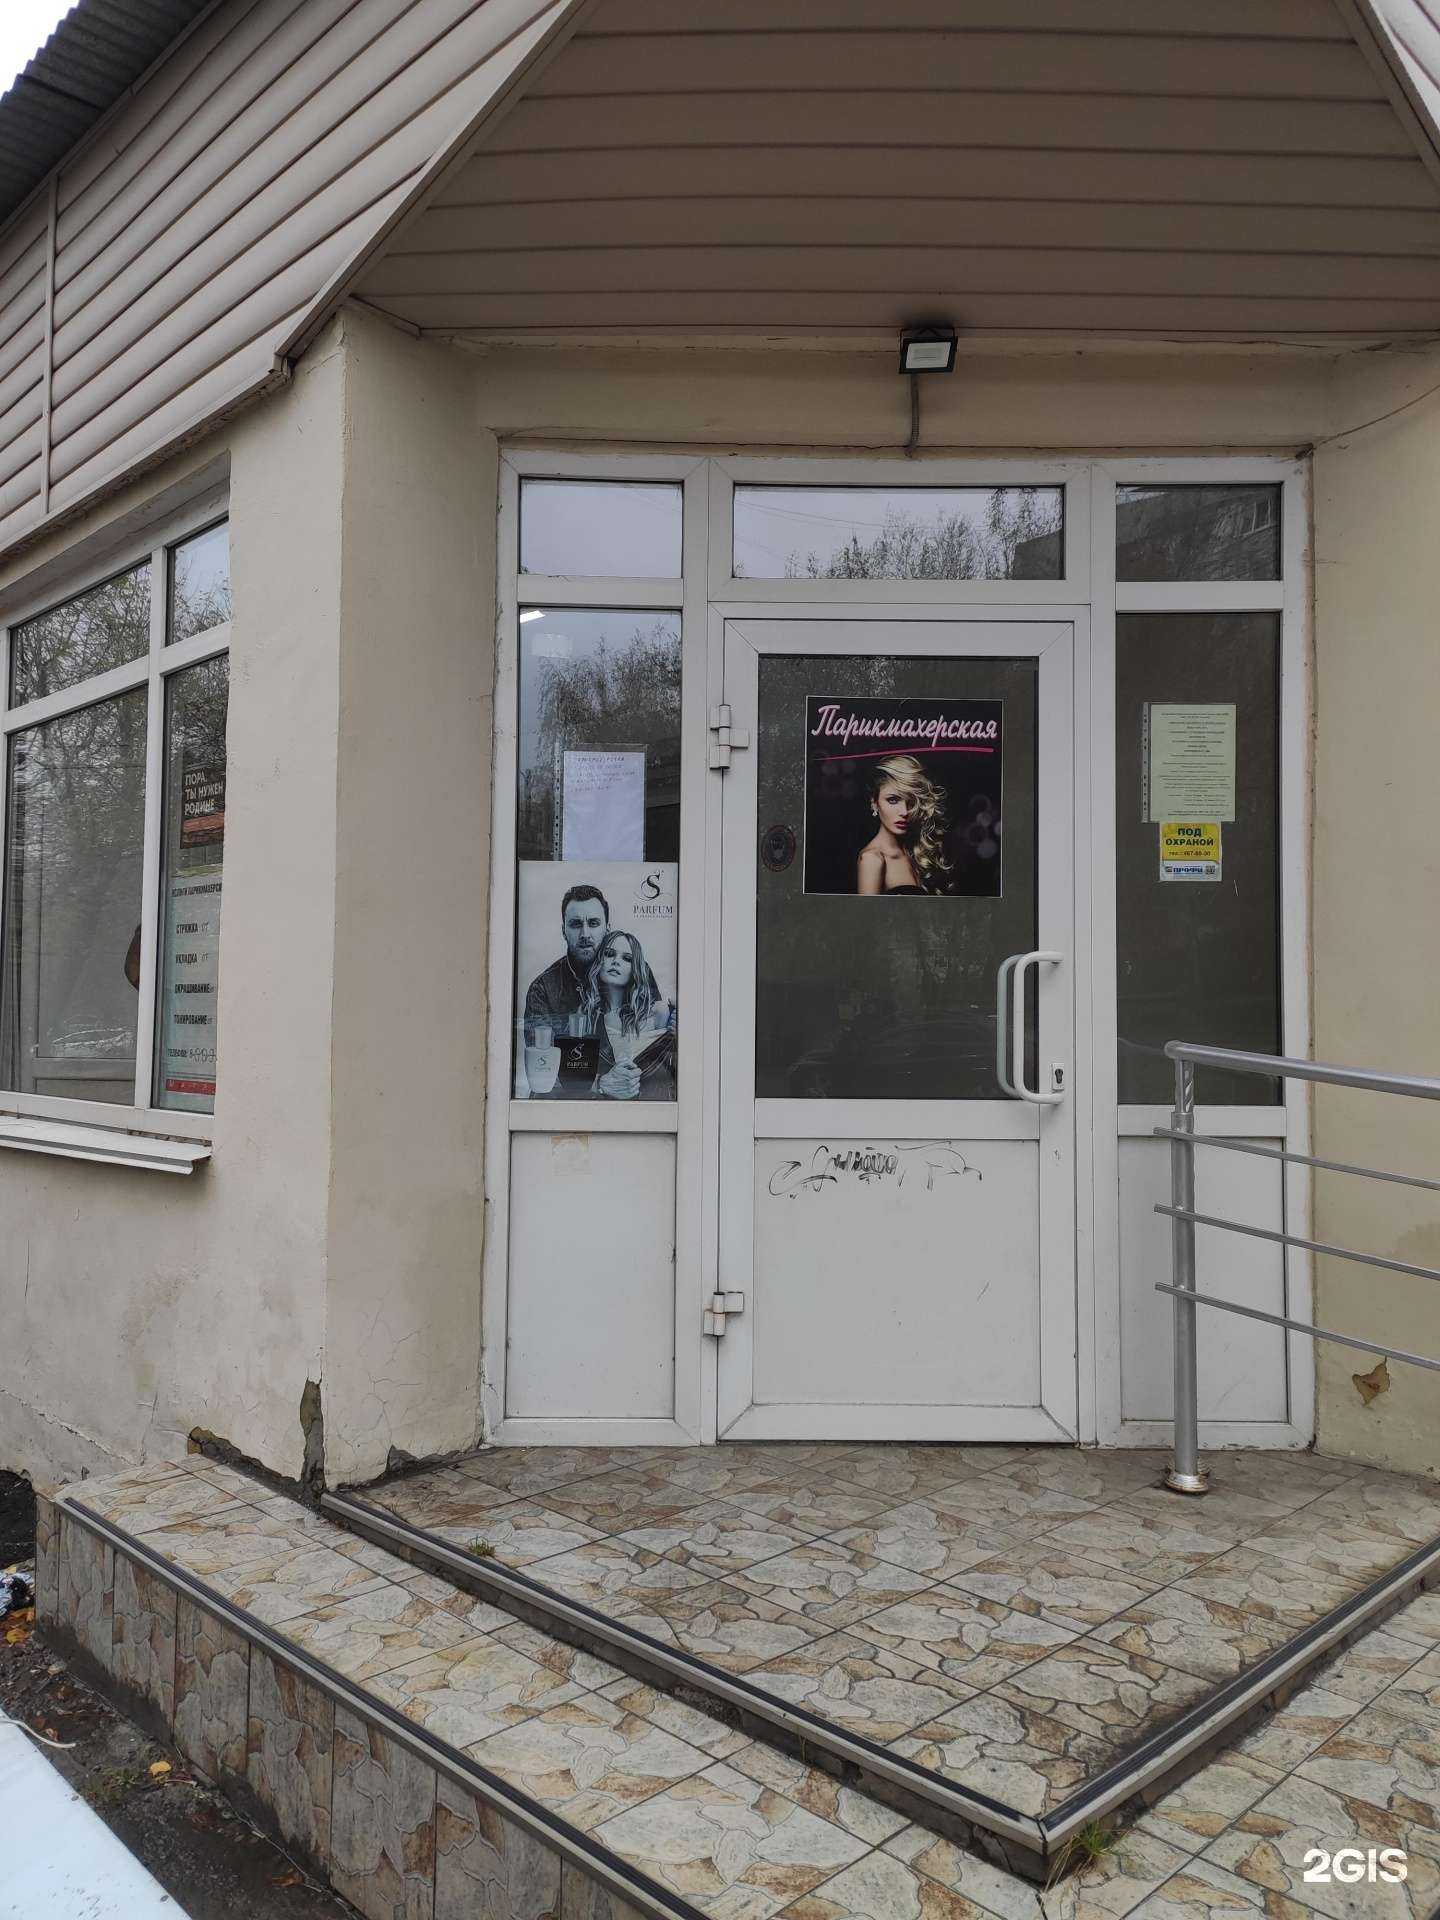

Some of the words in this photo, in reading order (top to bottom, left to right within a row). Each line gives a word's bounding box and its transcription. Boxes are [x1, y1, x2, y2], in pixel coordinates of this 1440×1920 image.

[811, 704, 998, 747] Парикмахерская
[184, 787, 197, 800] ТЫ
[198, 780, 224, 799] НУЖЕН
[184, 798, 215, 817] РОДИНЕ
[1177, 828, 1202, 838] ПОД
[1166, 836, 1214, 846] ОХРАНОЙ
[633, 904, 673, 915] PARFUM
